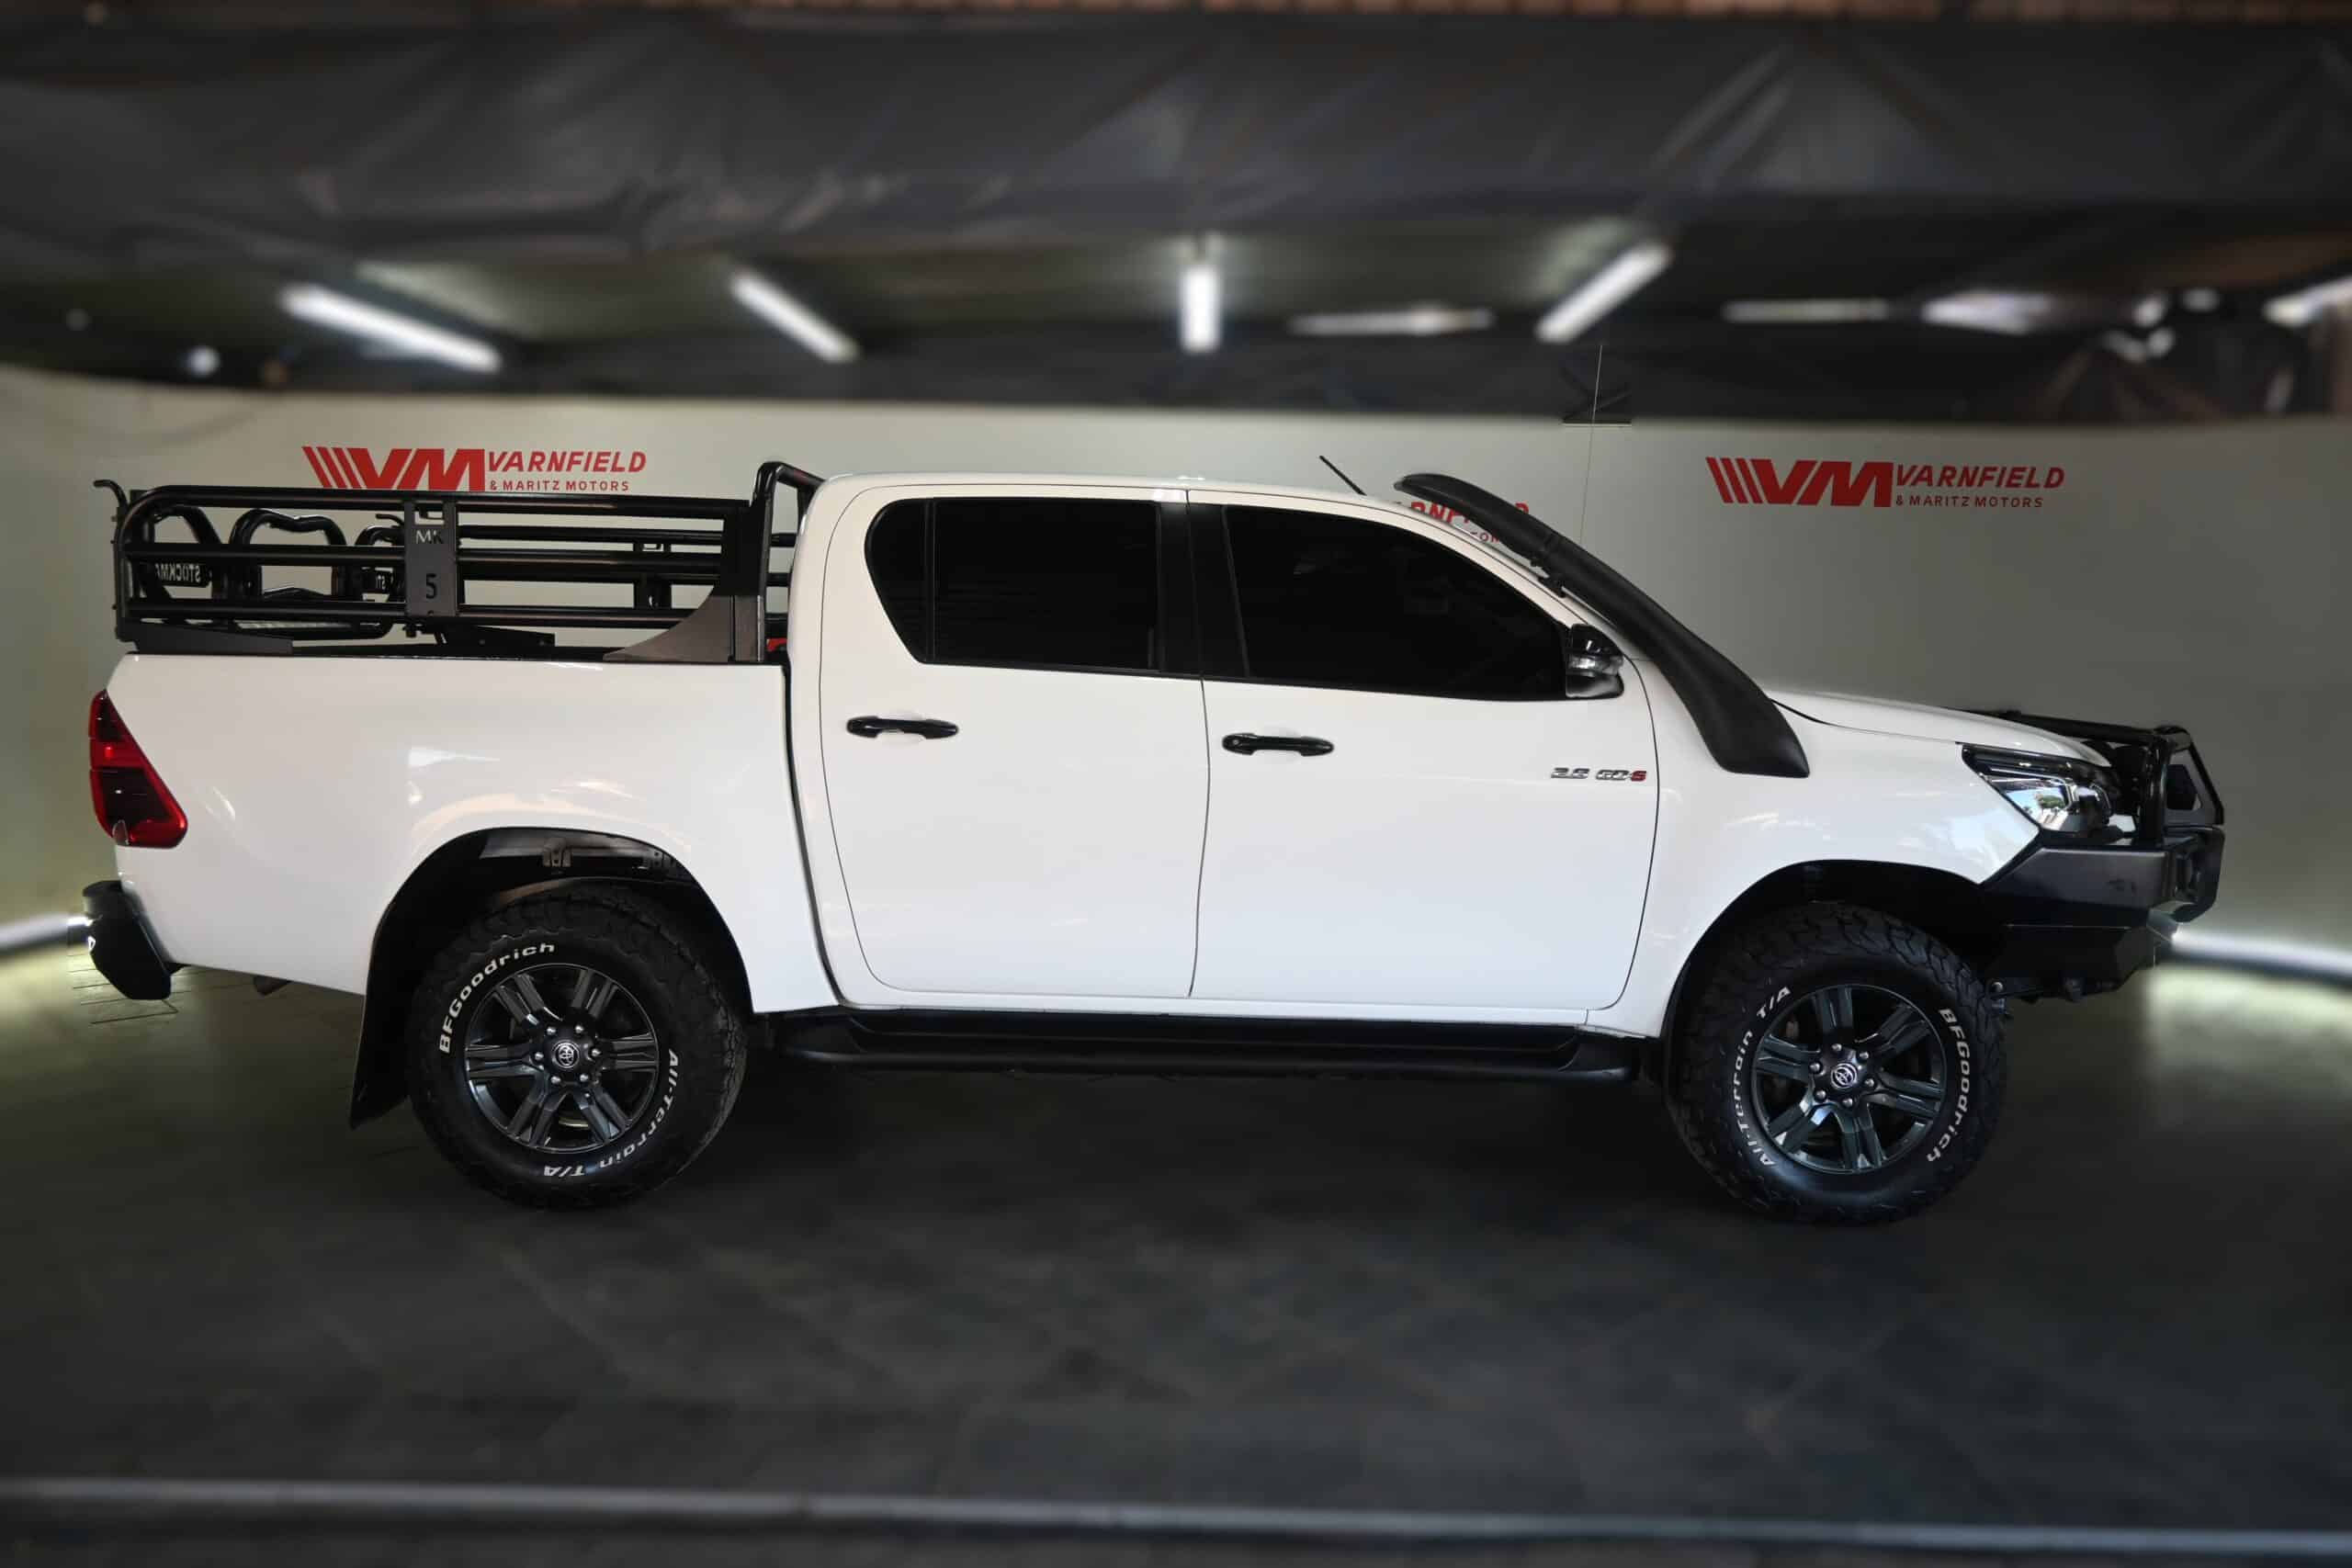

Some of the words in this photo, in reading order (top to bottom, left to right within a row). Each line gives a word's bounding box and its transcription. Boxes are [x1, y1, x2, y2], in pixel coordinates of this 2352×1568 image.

[344, 446, 486, 492] VM
[488, 450, 647, 472] VARNFIELD
[490, 479, 498, 491] &
[503, 479, 560, 491] MARITZ
[566, 480, 629, 491] MOTORS
[1748, 457, 1894, 508] VM
[1895, 464, 2065, 489] VARNFIELD
[1895, 496, 1904, 506] &
[1908, 496, 1971, 507] MARITZ
[1974, 496, 2043, 508] MOTORS
[425, 572, 438, 600] 5
[438, 942, 555, 1055] BFGoodrich
[1756, 986, 1792, 1020] T/A
[1926, 1008, 1972, 1163] BFGoodrich
[543, 1164, 585, 1178] T/A
